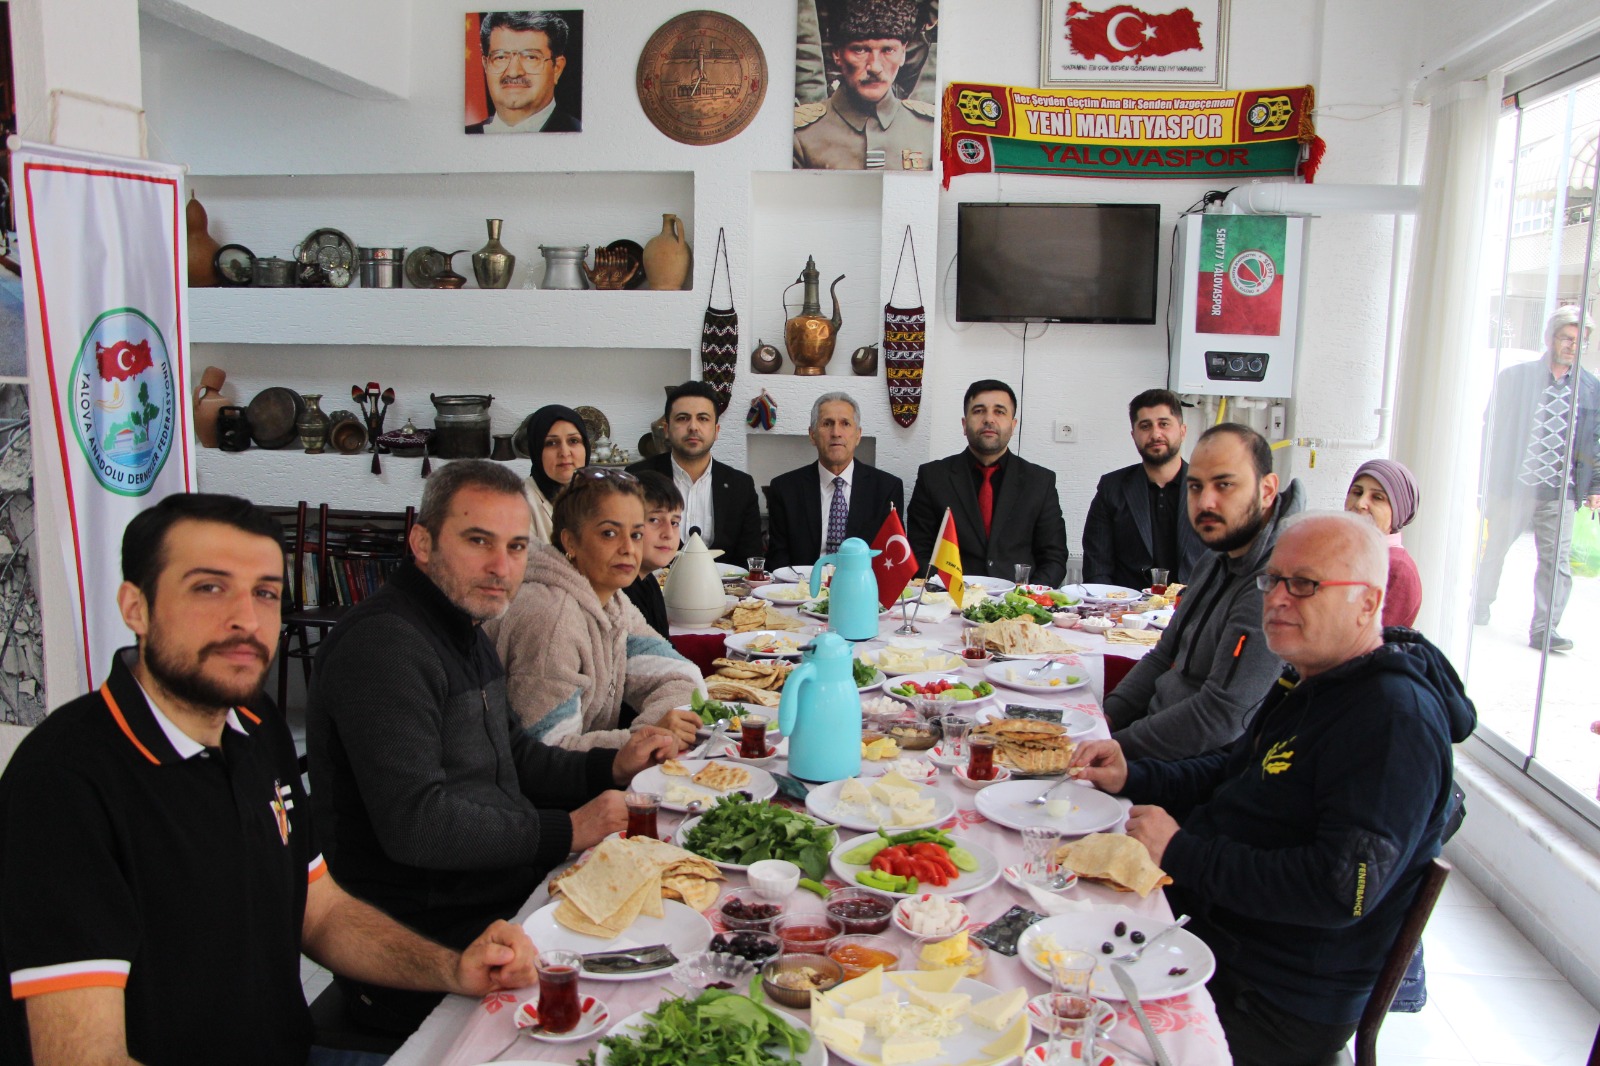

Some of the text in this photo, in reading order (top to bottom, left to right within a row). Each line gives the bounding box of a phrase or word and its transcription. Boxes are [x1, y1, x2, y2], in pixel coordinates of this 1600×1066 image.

[1013, 93, 1235, 111] Her Şeyden Geçtim Ama Bir Senden Vazgeçemem
[1025, 109, 1222, 139] YENİ MALATYASPOR
[1040, 144, 1249, 167] YALOVASPOR
[1211, 228, 1226, 316] SEMT77 YALOVASPOR
[1263, 259, 1273, 279] SEMT
[81, 373, 93, 433] YALOVA
[89, 437, 124, 482] ANADOLU
[157, 362, 171, 452] FEDERASYONU
